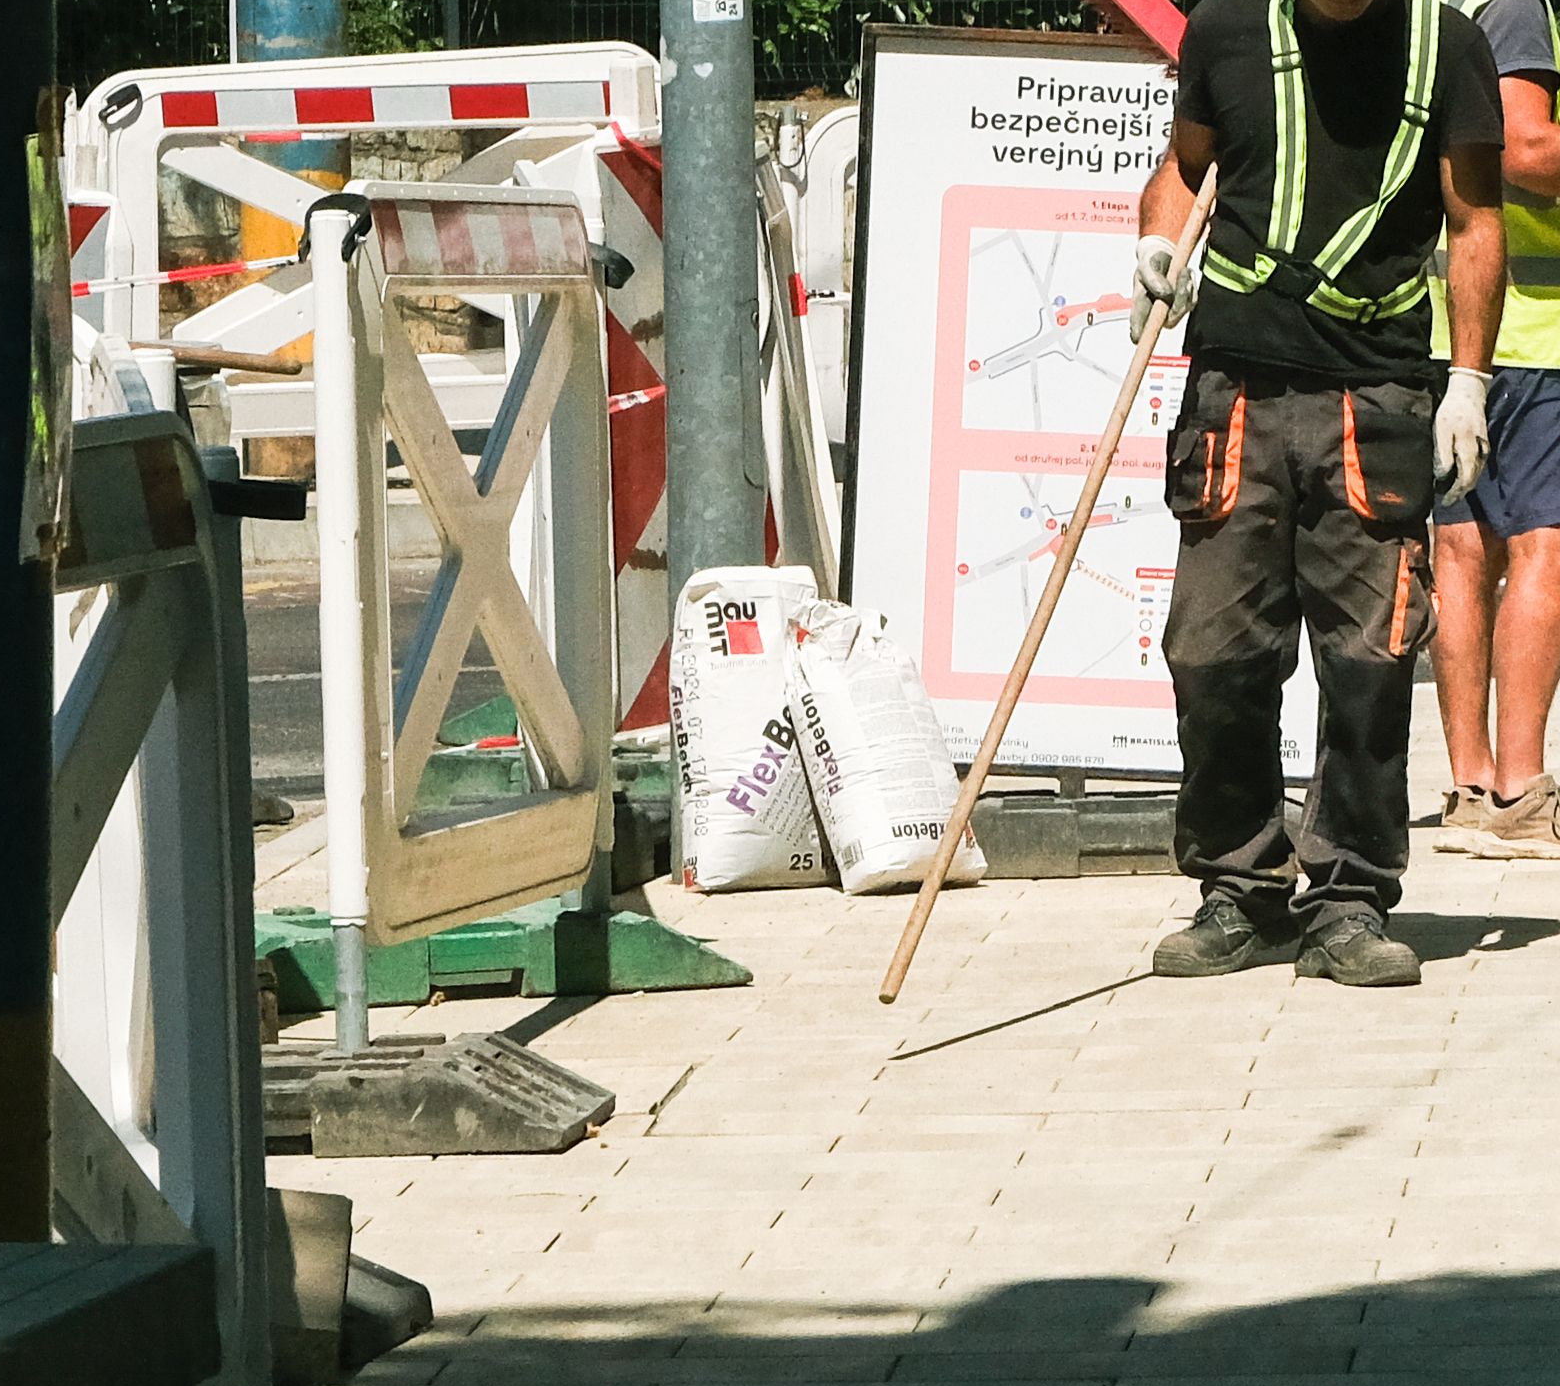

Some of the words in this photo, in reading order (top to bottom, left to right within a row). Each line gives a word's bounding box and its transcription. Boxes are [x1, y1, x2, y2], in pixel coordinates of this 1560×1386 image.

[970, 106, 1152, 142] bezpečnejší
[992, 141, 1103, 173] verejný
[1101, 201, 1130, 212] Etapa
[799, 691, 845, 798] FlexBeton
[789, 852, 814, 871] 25
